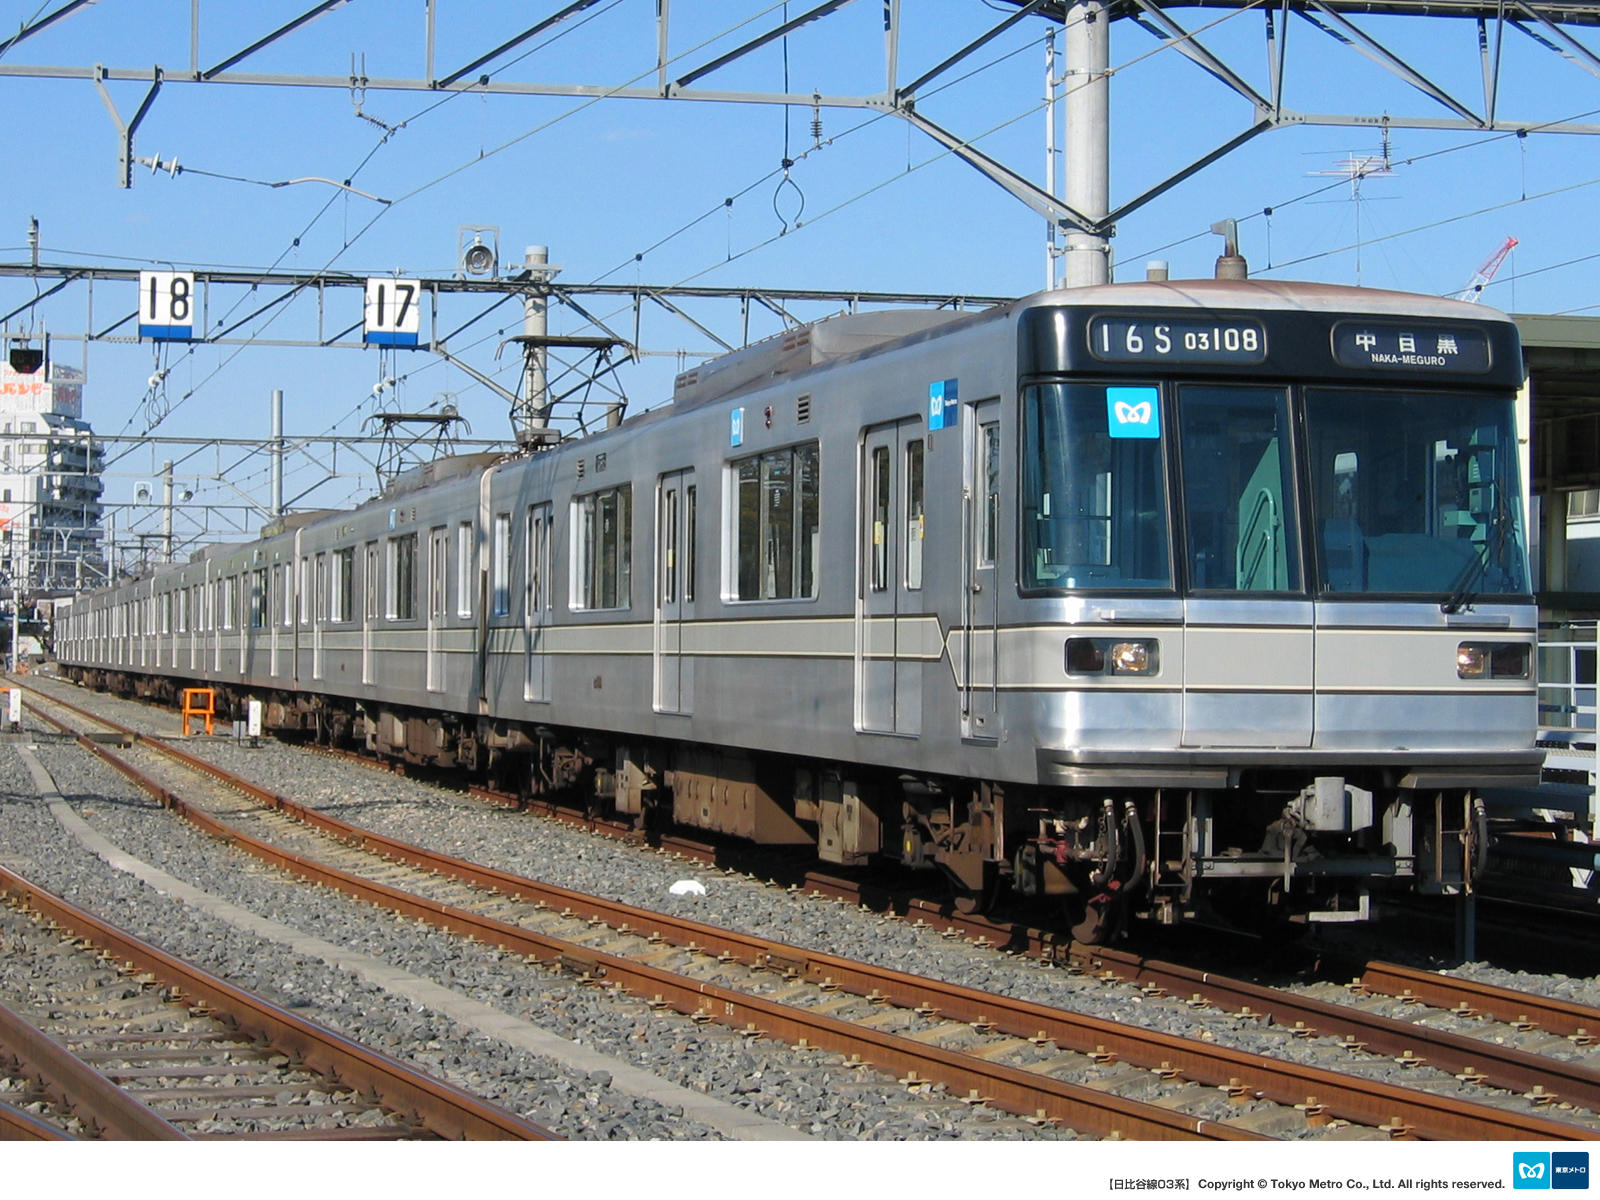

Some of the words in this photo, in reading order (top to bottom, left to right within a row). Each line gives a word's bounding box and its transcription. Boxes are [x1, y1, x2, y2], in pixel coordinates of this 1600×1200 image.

[150, 276, 190, 321] 18
[376, 284, 416, 328] 17
[1184, 327, 1258, 352] 03108
[1355, 330, 1459, 355] 中目黒
[1371, 353, 1446, 366] NAKA-MEGURO
